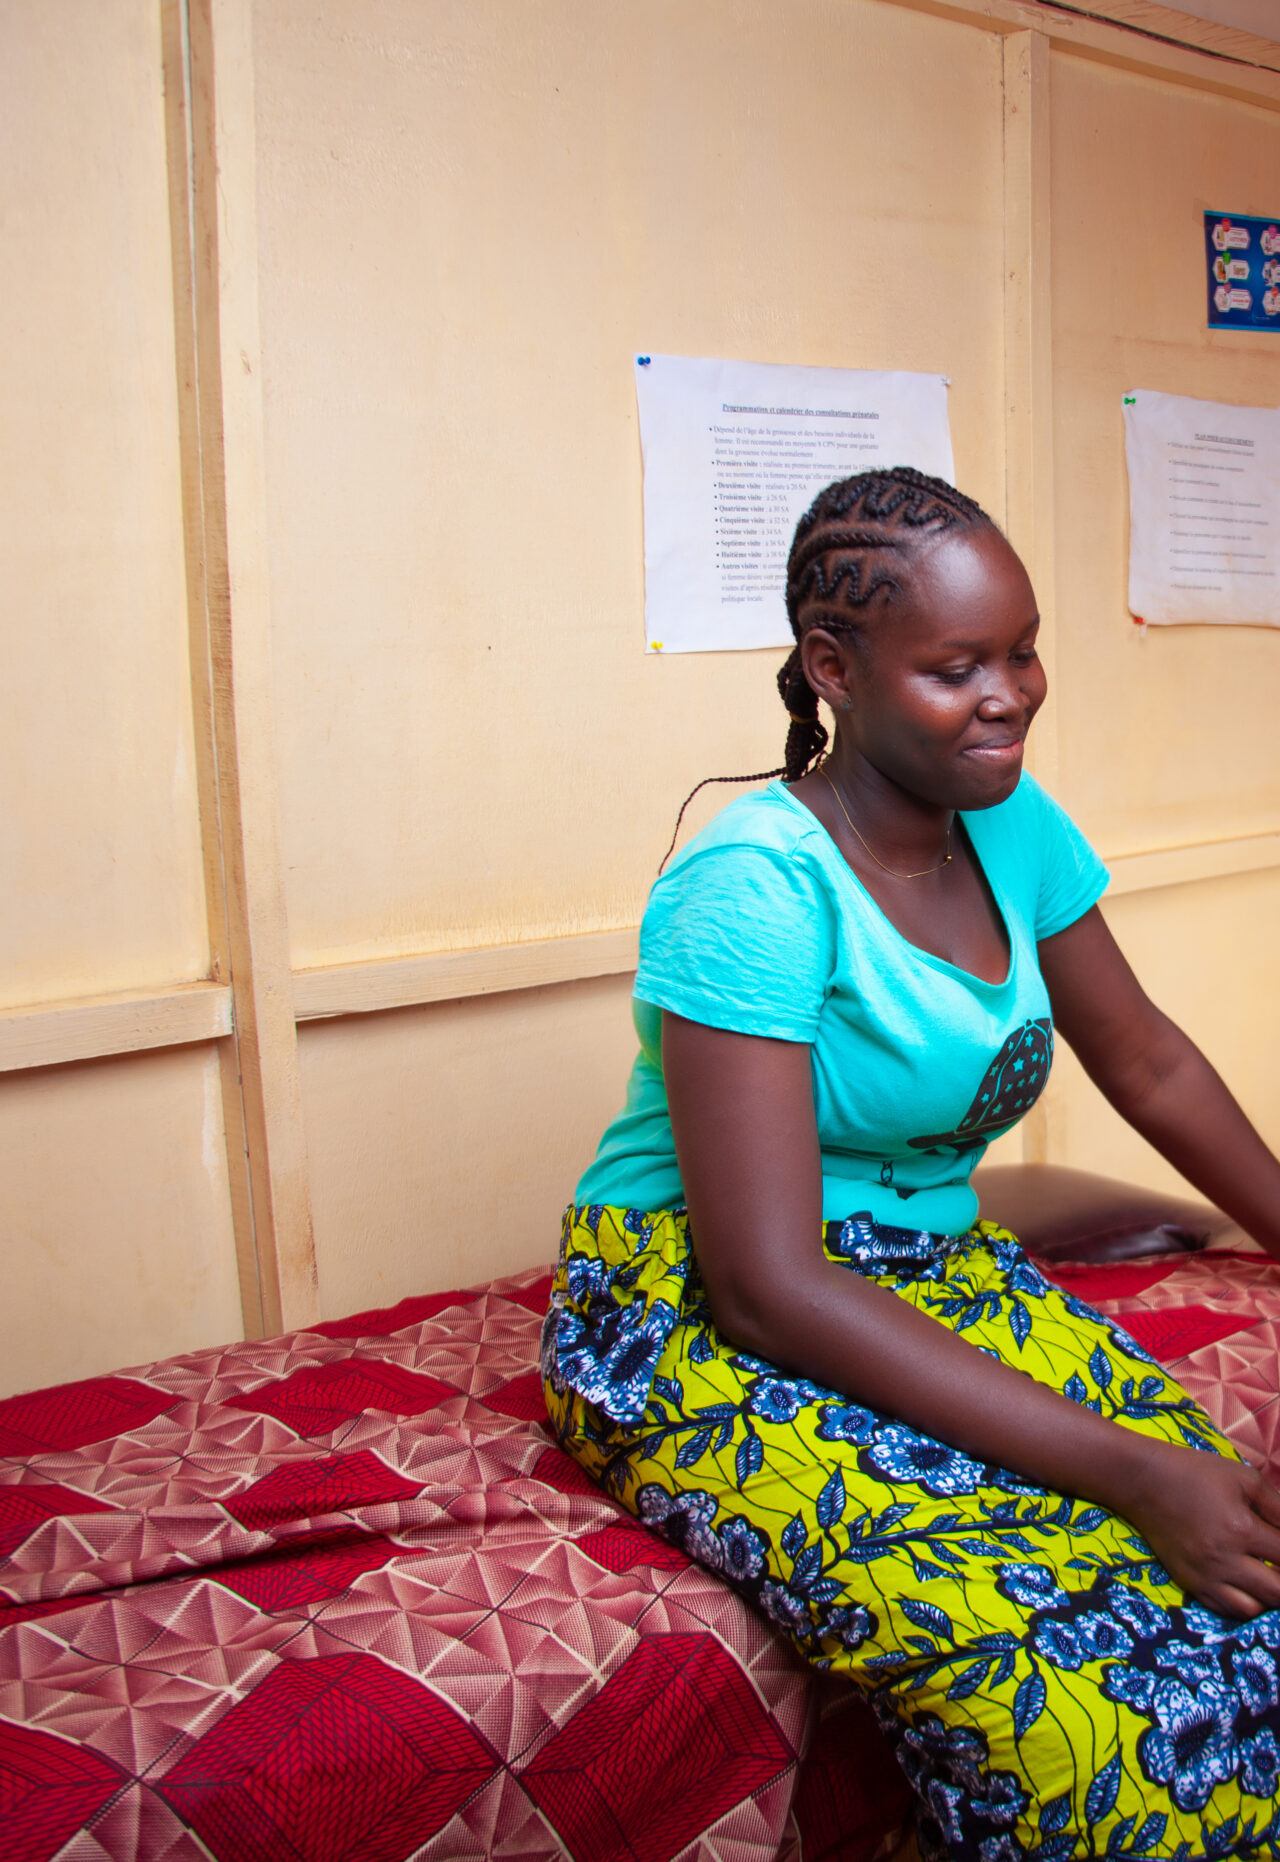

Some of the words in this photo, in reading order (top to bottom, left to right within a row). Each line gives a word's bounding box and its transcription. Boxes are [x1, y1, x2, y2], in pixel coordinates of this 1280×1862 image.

[722, 403, 768, 415] Programmation
[815, 409, 851, 419] consultations
[716, 459, 742, 468] Première
[743, 459, 758, 469] visite
[718, 482, 745, 490] Deuxième
[746, 482, 761, 491] visite
[719, 493, 746, 502] Troisième
[747, 494, 762, 503] visite
[719, 505, 748, 514] Quatrième
[750, 505, 765, 514] visite
[719, 516, 749, 526] Cinquième
[751, 517, 766, 526] visite
[720, 528, 742, 536] Sixième
[743, 528, 757, 537] visite
[721, 540, 746, 549] Septième
[721, 551, 746, 559] Huitième
[747, 551, 762, 559] visite
[721, 562, 741, 570] Autres
[741, 562, 758, 570] visites
